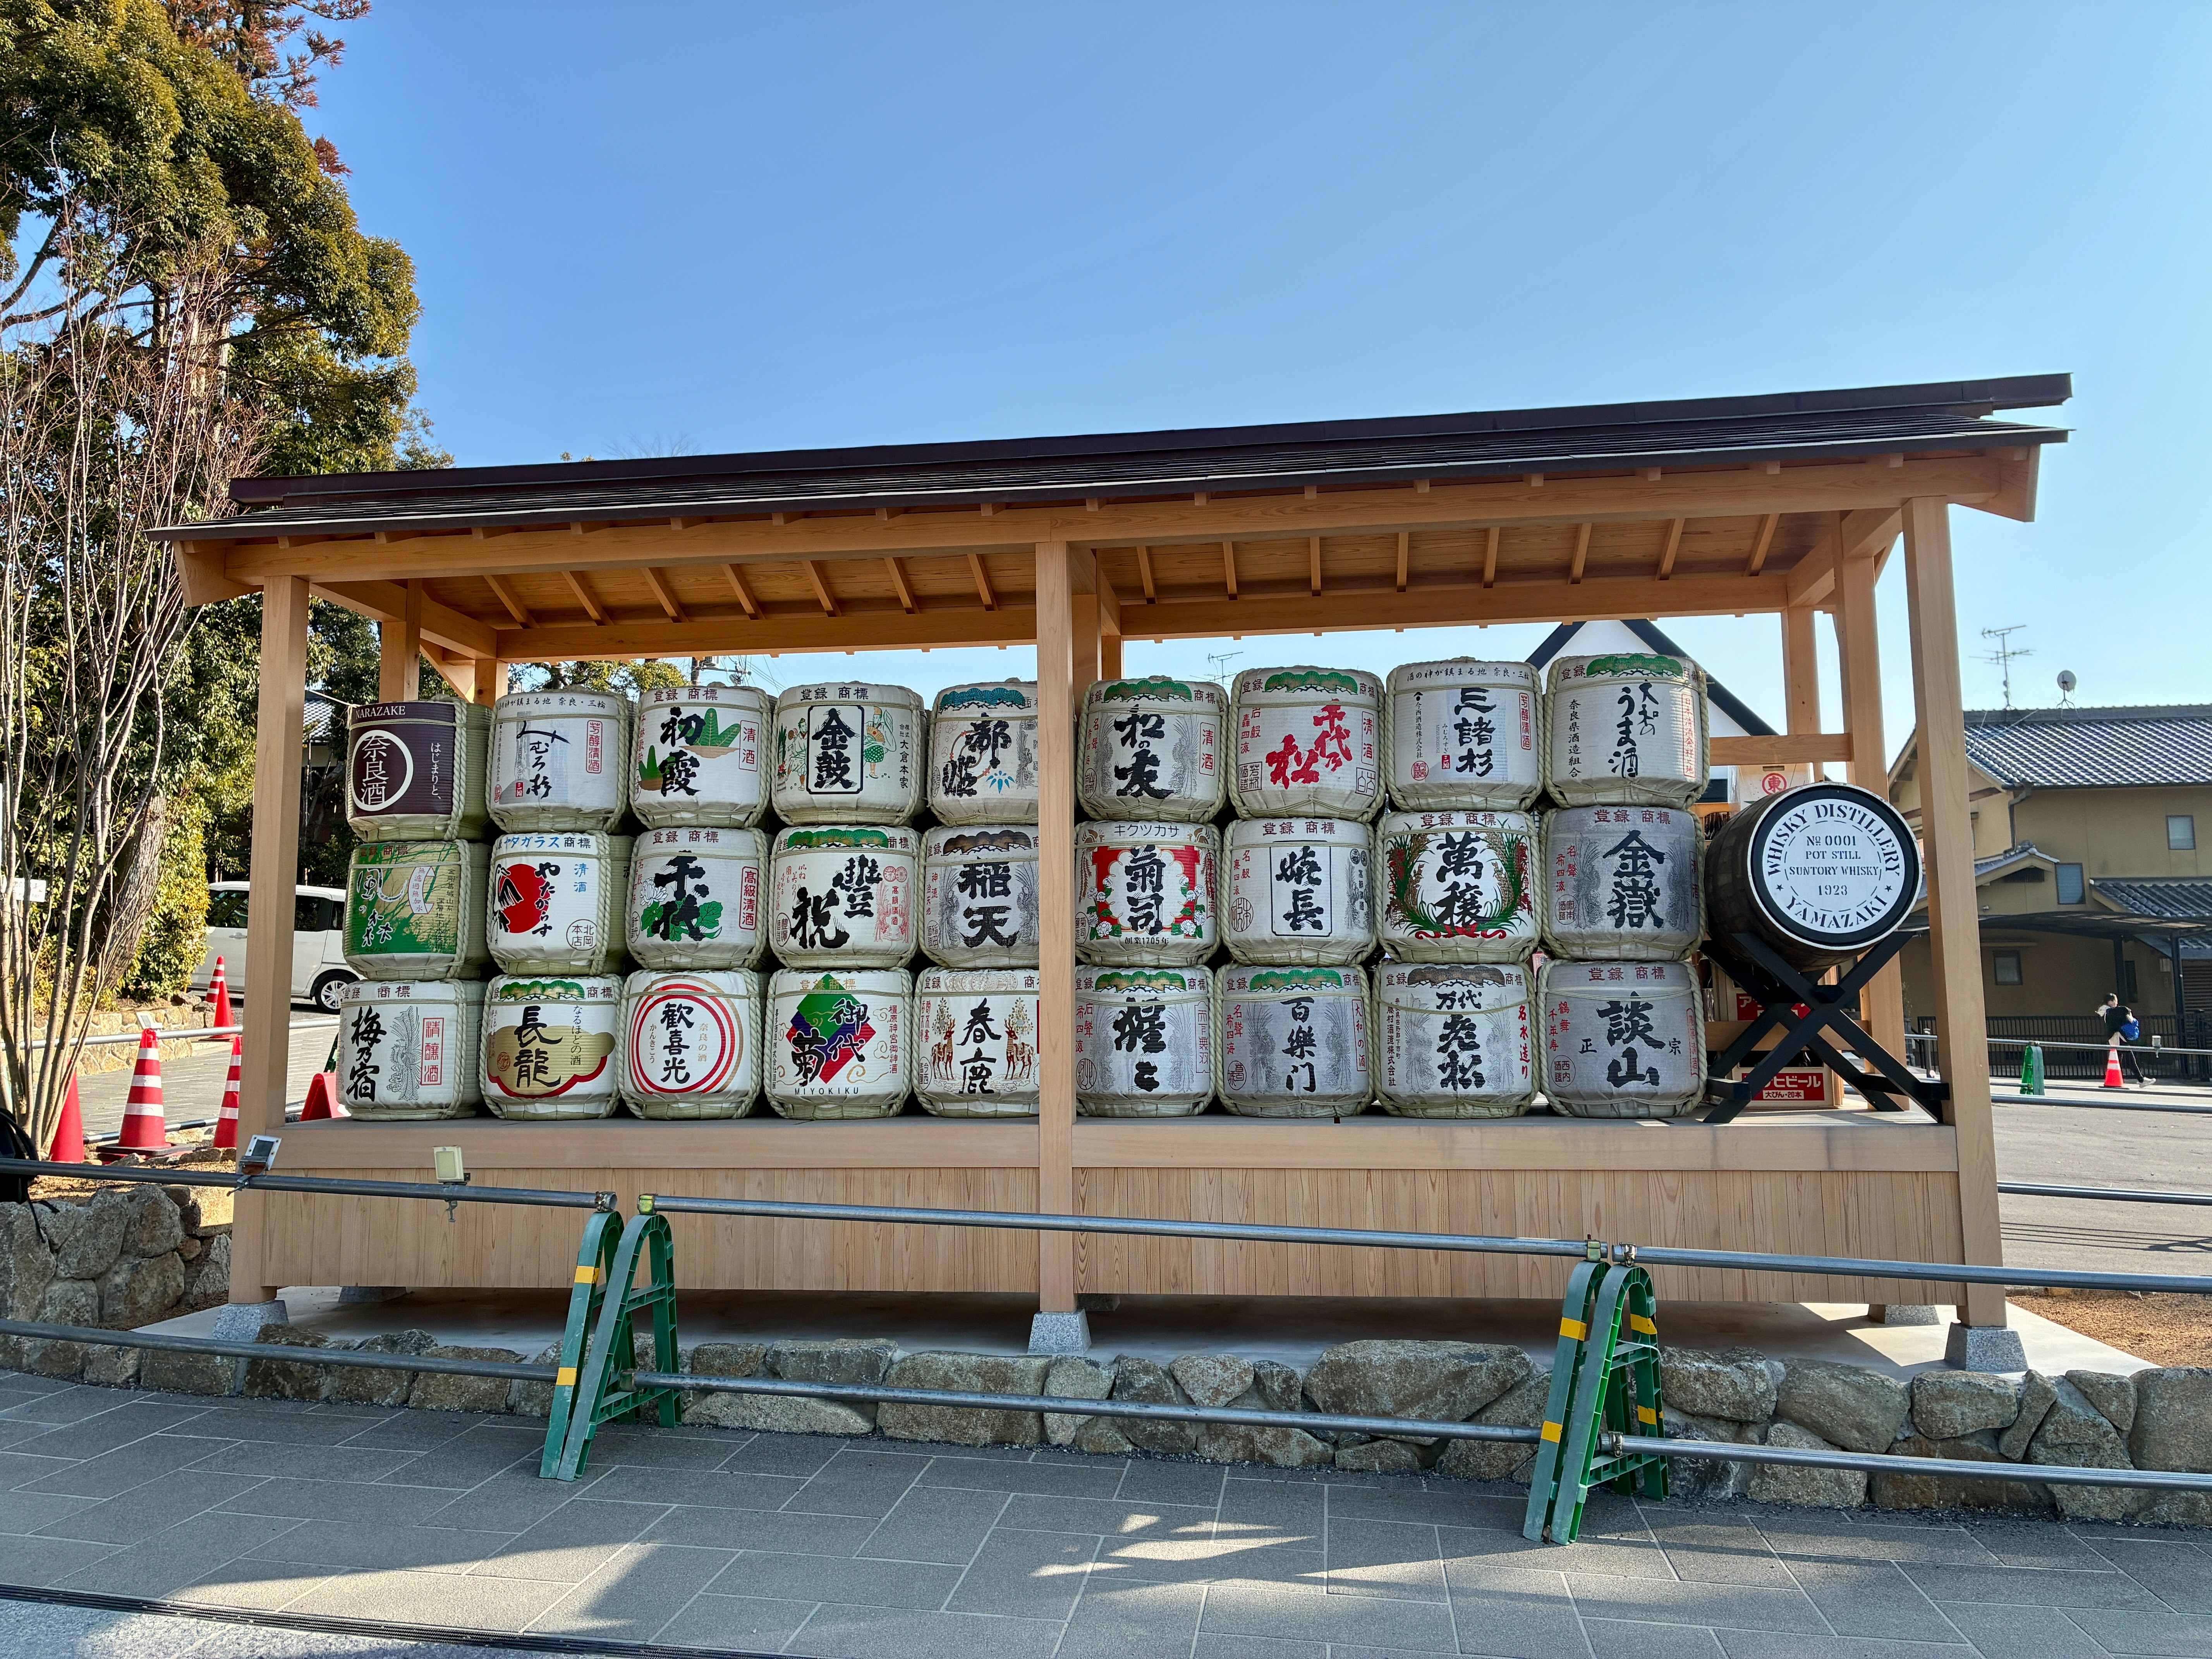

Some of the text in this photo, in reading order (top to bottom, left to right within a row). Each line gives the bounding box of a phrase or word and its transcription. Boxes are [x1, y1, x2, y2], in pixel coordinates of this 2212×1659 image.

[356, 706, 405, 719] NARAZAKE
[1454, 687, 1496, 777] 三諸杉
[660, 706, 701, 797] 初霞
[743, 727, 756, 765] 清酒
[812, 708, 860, 789] 金鼓
[1202, 729, 1214, 770] 清酒
[1363, 718, 1373, 759] 清酒
[1568, 699, 1582, 777] 奈良県酒造組合
[361, 736, 390, 805] 奈良酒
[431, 742, 441, 800] はじまりと、
[1768, 776, 1781, 792] 東
[504, 836, 560, 848] ヤタガラス
[1114, 824, 1180, 836] キクツカサ
[1767, 804, 1900, 876] WHISKY DISTILLERY
[1825, 835, 1856, 846] 0001
[1790, 866, 1879, 876] SUNTORY WHISKY
[1806, 851, 1861, 860] POT STILL
[574, 863, 589, 893] 清酒
[1818, 884, 1848, 896] 1923
[532, 862, 560, 937] やたがらす
[1786, 895, 1888, 929] YAMAZAKI
[346, 1005, 387, 1102] 梅乃宿
[570, 1005, 583, 1065] なるほどの酒
[698, 1023, 708, 1062] 奈良の酒
[956, 997, 1002, 1094] 春鹿
[1355, 1003, 1365, 1067] 大和の酒
[1518, 1005, 1530, 1079] 名水造り
[1596, 991, 1666, 1088] 談山
[795, 1087, 859, 1095] MIYOKIKU
